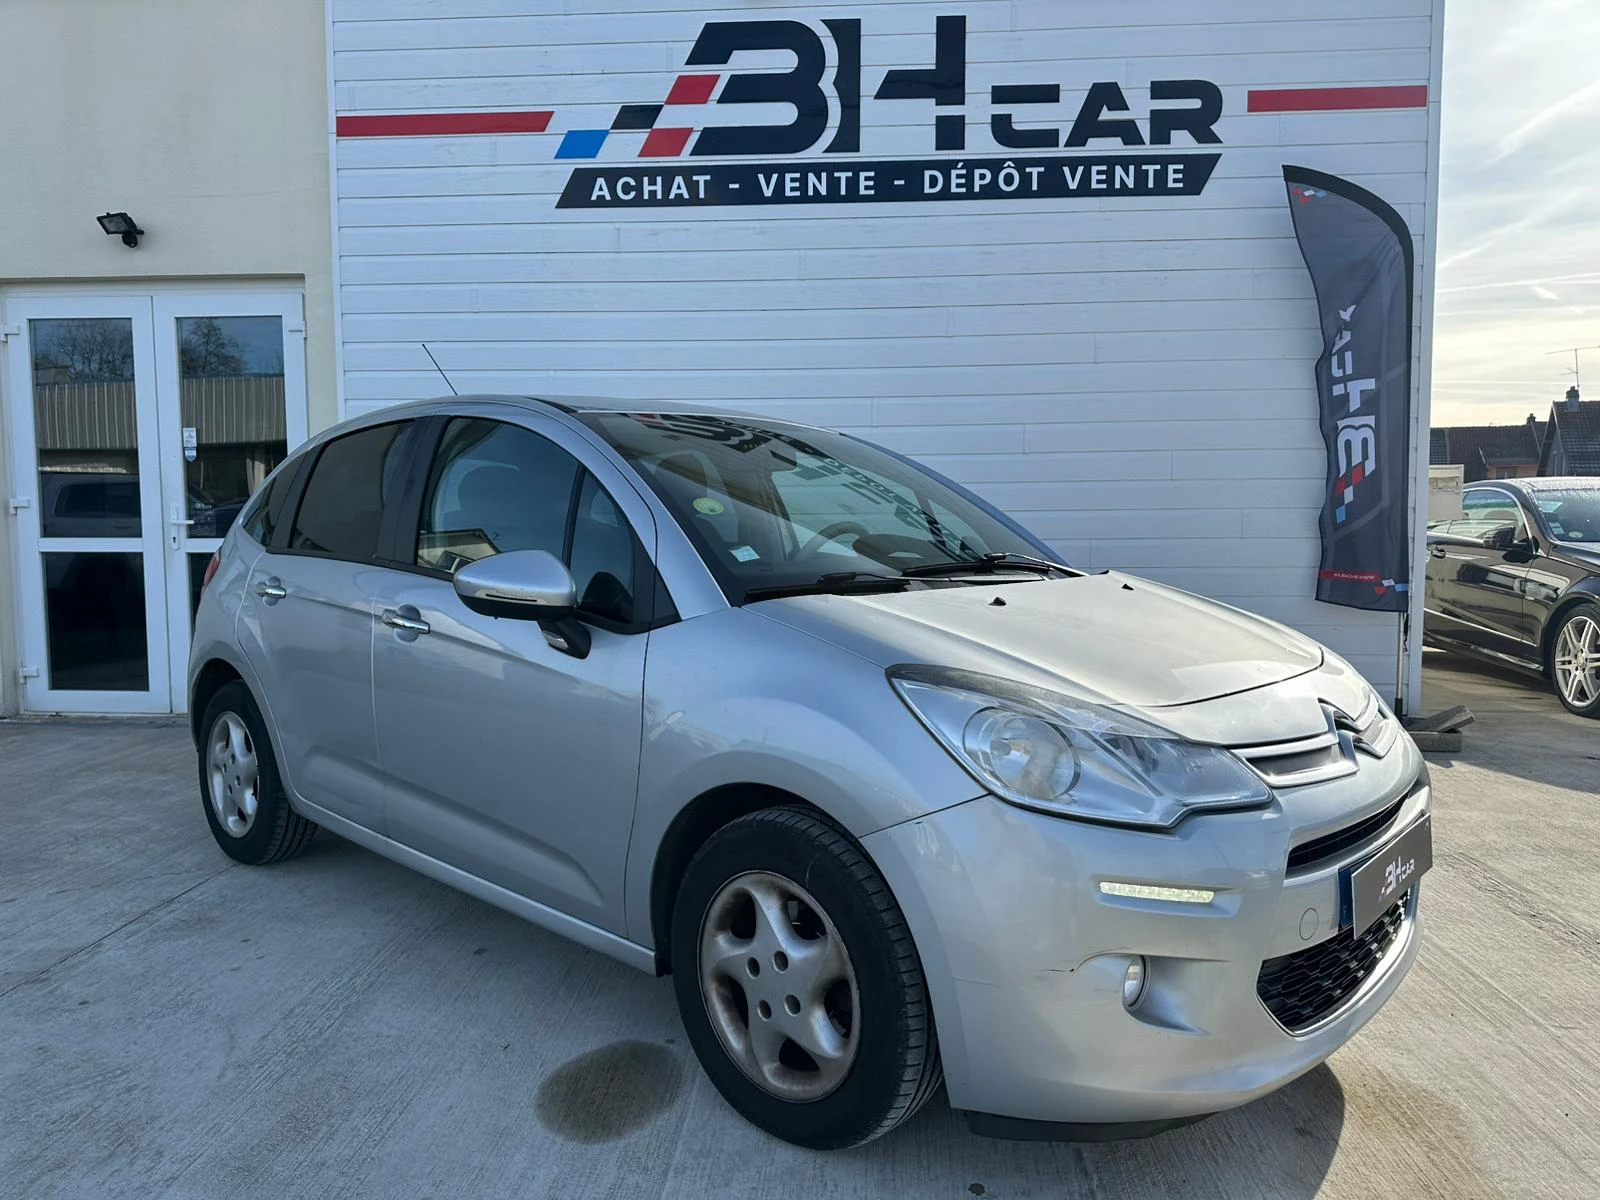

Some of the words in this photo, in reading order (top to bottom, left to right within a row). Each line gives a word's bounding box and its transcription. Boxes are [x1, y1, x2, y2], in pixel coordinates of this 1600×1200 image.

[590, 174, 711, 201] ACHAT
[757, 171, 875, 198] VENTE
[923, 161, 1045, 194] DÉPÔT
[1062, 164, 1184, 190] VENTE
